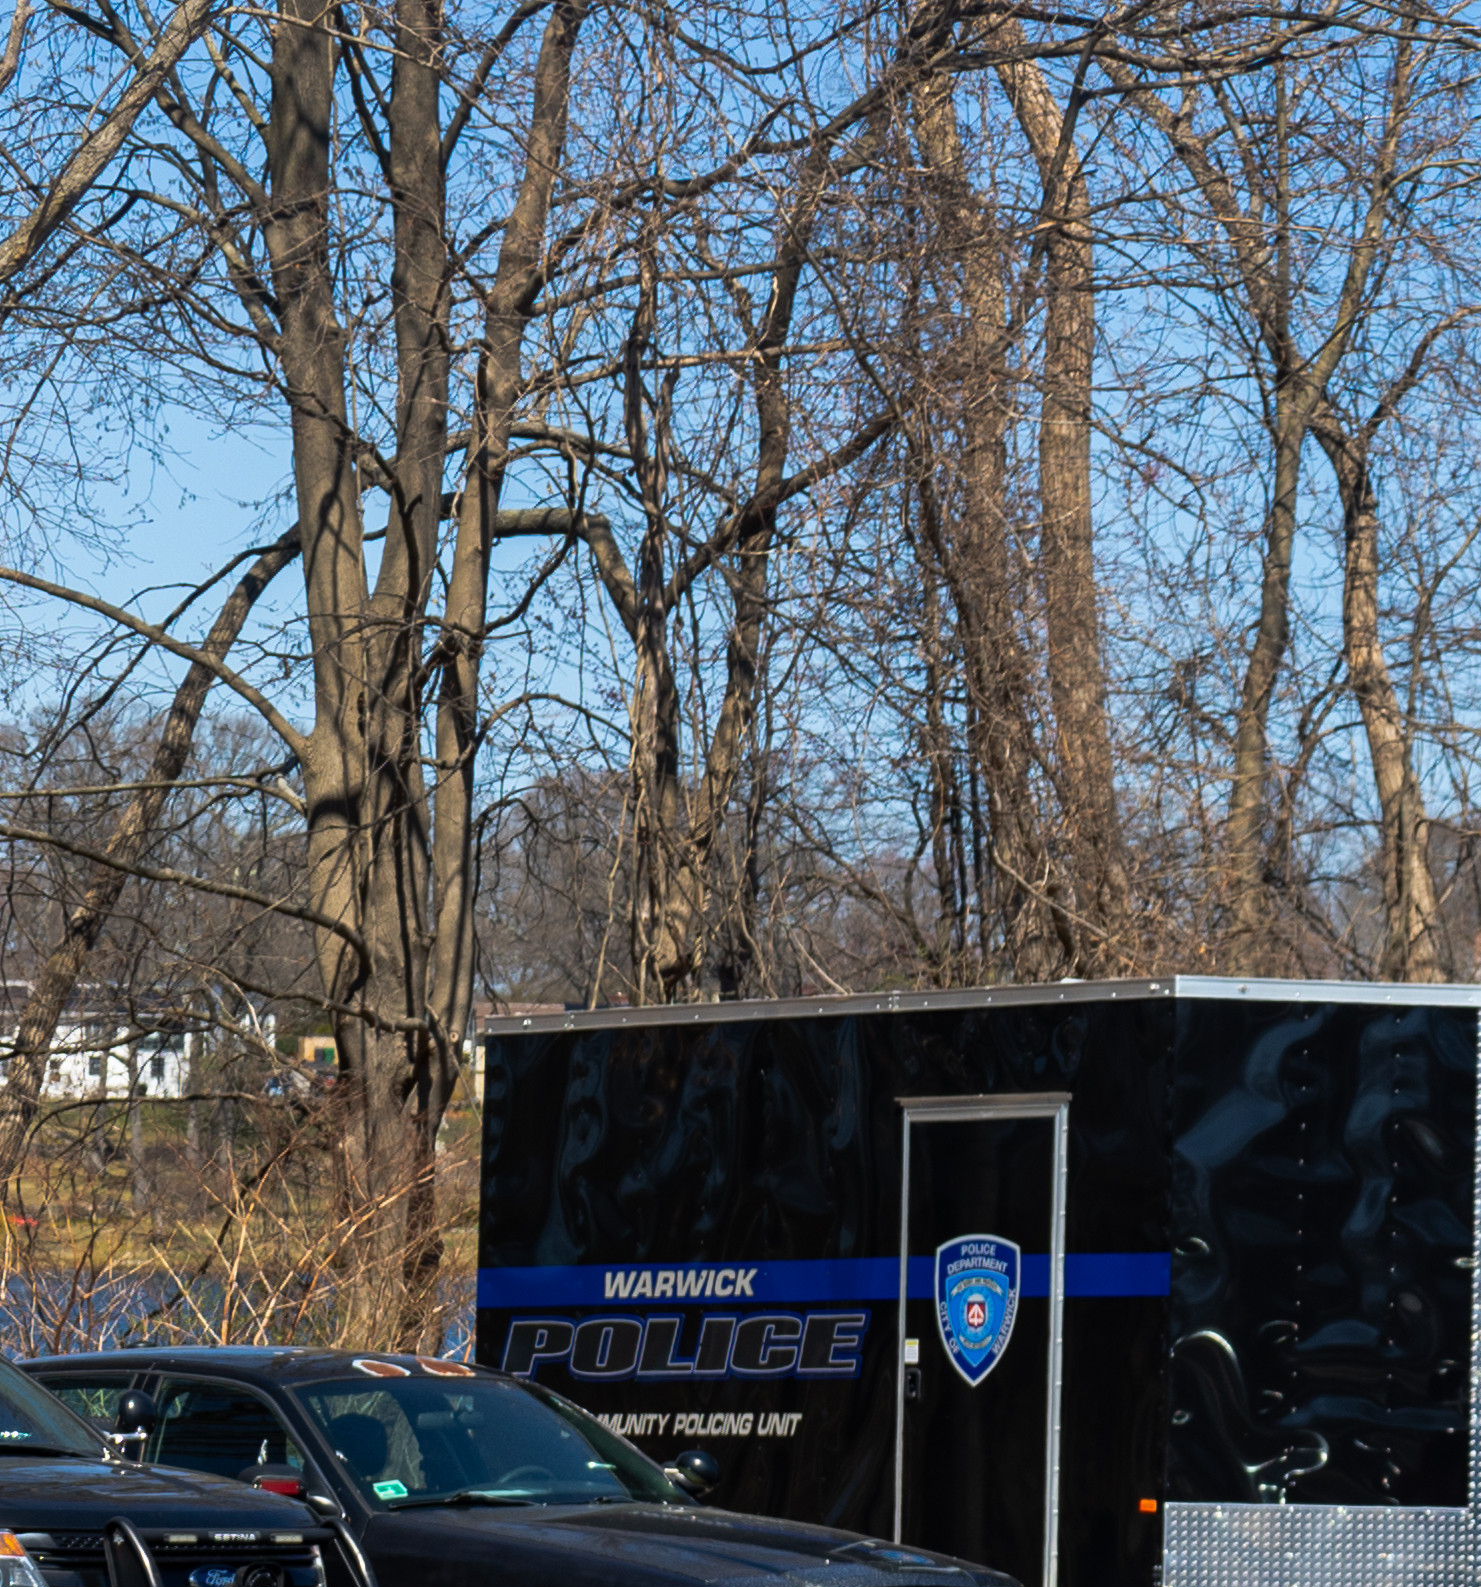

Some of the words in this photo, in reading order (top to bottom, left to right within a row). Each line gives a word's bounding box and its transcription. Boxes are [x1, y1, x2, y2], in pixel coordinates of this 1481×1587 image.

[960, 1243, 997, 1256] POLICE
[947, 1256, 1008, 1274] DEPARTMENT
[604, 1267, 758, 1299] WARWICK
[992, 1287, 1017, 1355] WARWICK
[502, 1309, 871, 1382] POLICE
[673, 1413, 754, 1437] POLICING
[757, 1413, 803, 1437] UNIT
